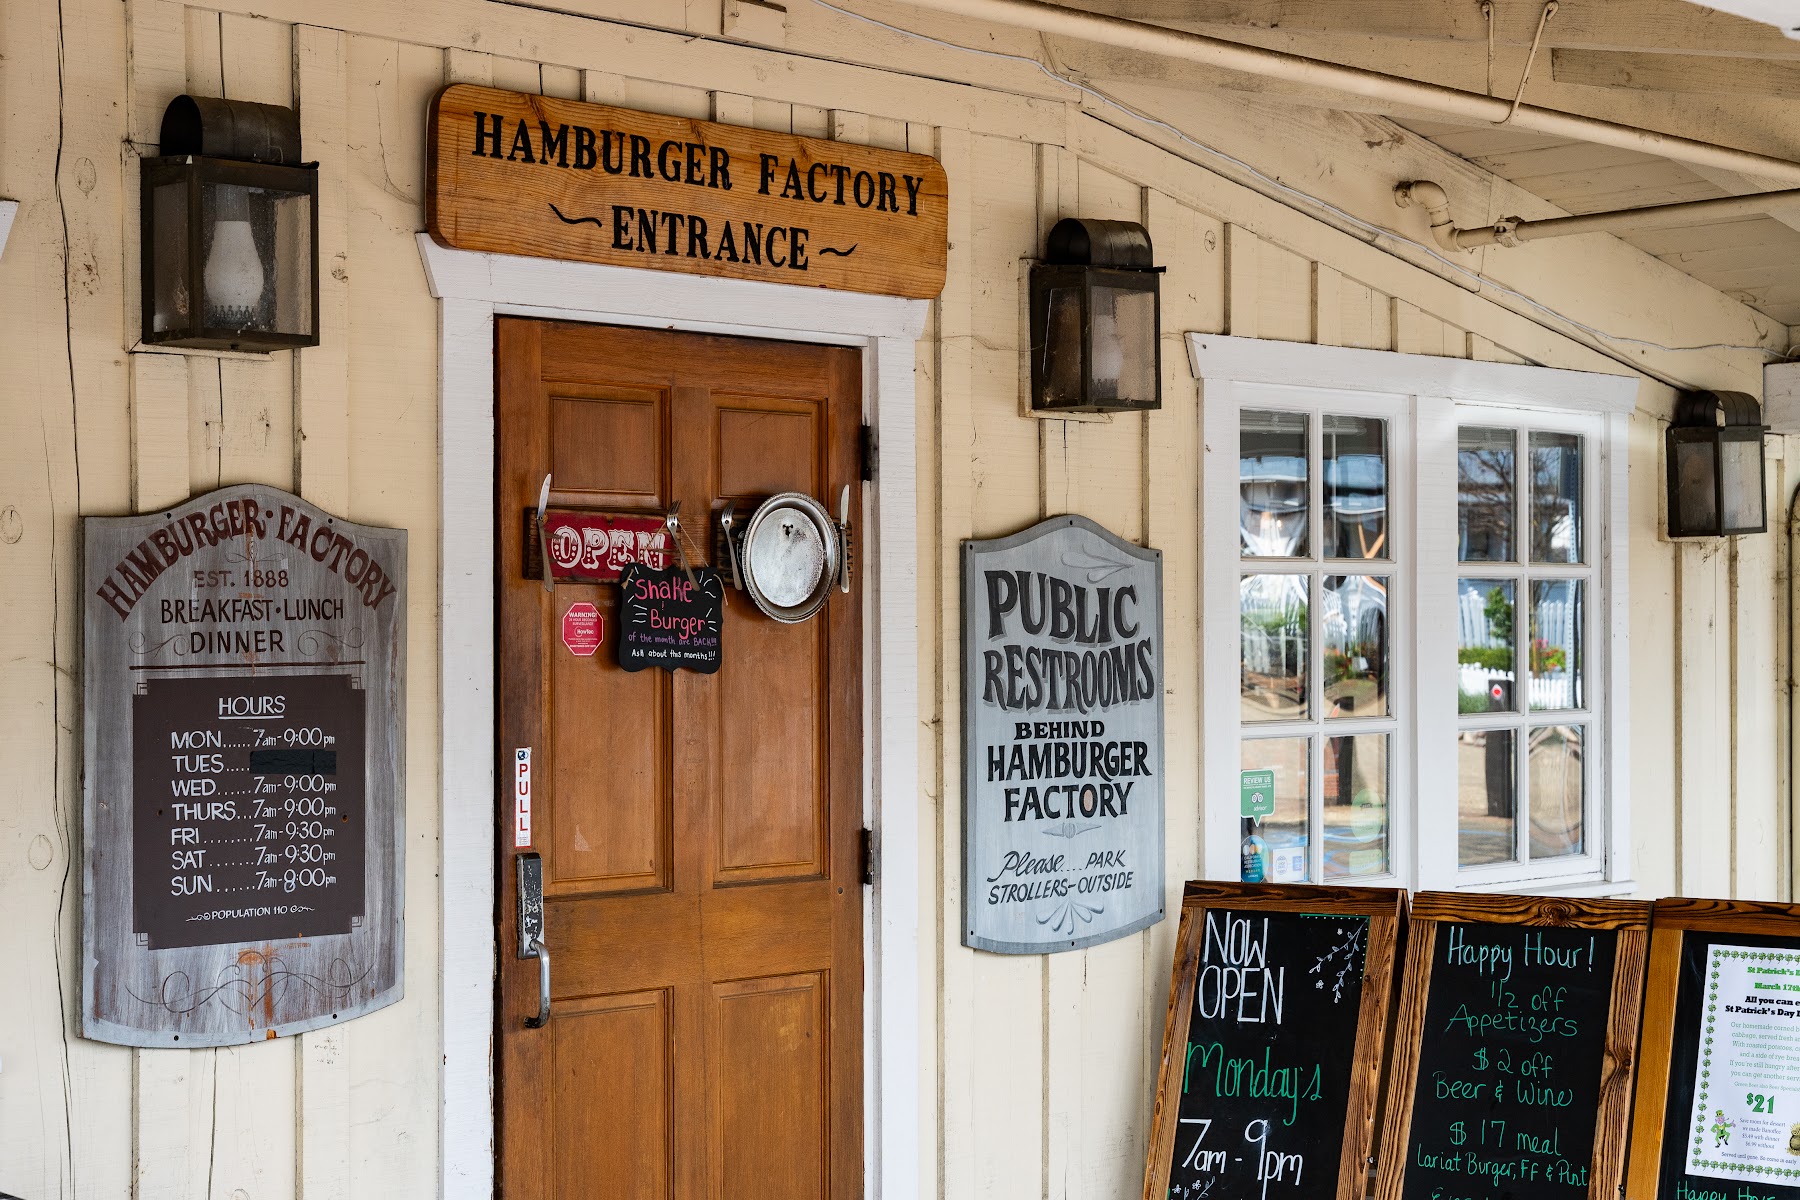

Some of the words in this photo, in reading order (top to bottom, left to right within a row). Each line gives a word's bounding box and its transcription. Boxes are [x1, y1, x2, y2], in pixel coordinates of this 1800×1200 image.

[471, 111, 733, 191] HAMBURGER
[757, 153, 924, 217] FACTORY
[611, 204, 810, 271] ENTRANCE
[96, 498, 267, 623] HAMBURGER
[275, 505, 397, 610] FACTORY
[551, 525, 666, 571] OPEN
[194, 570, 235, 588] EST.
[244, 569, 289, 588] 1888
[634, 576, 693, 603] Shake
[983, 569, 1139, 644] PUBLIC
[650, 608, 705, 640] Burger
[190, 629, 285, 654] DINNER
[628, 632, 637, 642] of
[640, 633, 653, 643] the
[654, 636, 676, 645] month
[678, 638, 691, 646] are
[631, 649, 645, 657] Ask
[647, 649, 668, 658] about
[669, 649, 682, 658] this
[983, 637, 1155, 716] RESTROOMS
[218, 695, 286, 716] HOURS
[1014, 720, 1105, 740] BEHIND
[987, 741, 1153, 783] HAMBURGER
[1243, 777, 1263, 785] REVIEW
[518, 763, 529, 831] PULL
[1003, 781, 1135, 822] FACTORY
[1085, 850, 1126, 869] PARK
[211, 908, 271, 921] POPULATION
[273, 905, 288, 915] 110
[1447, 925, 1512, 981] Happy
[1756, 967, 1794, 975] Patrick's
[1198, 965, 1285, 1025] OPEN
[1531, 985, 1567, 1012] off
[1754, 982, 1781, 990] March
[1725, 1005, 1735, 1013] St
[1735, 1005, 1776, 1016] Patrick's
[1777, 1008, 1795, 1018] Day
[1744, 995, 1758, 1003] All
[1758, 998, 1774, 1006] you
[1444, 1003, 1578, 1043] Appetizers
[1521, 1051, 1553, 1078] off
[1183, 1041, 1322, 1126] Monday's
[1432, 1070, 1487, 1099] Beer
[1516, 1080, 1573, 1107] Wine
[1746, 1092, 1775, 1114] $21
[1516, 1127, 1562, 1156] meal
[1417, 1143, 1461, 1172] Lariat
[1556, 1159, 1588, 1187] Pint
